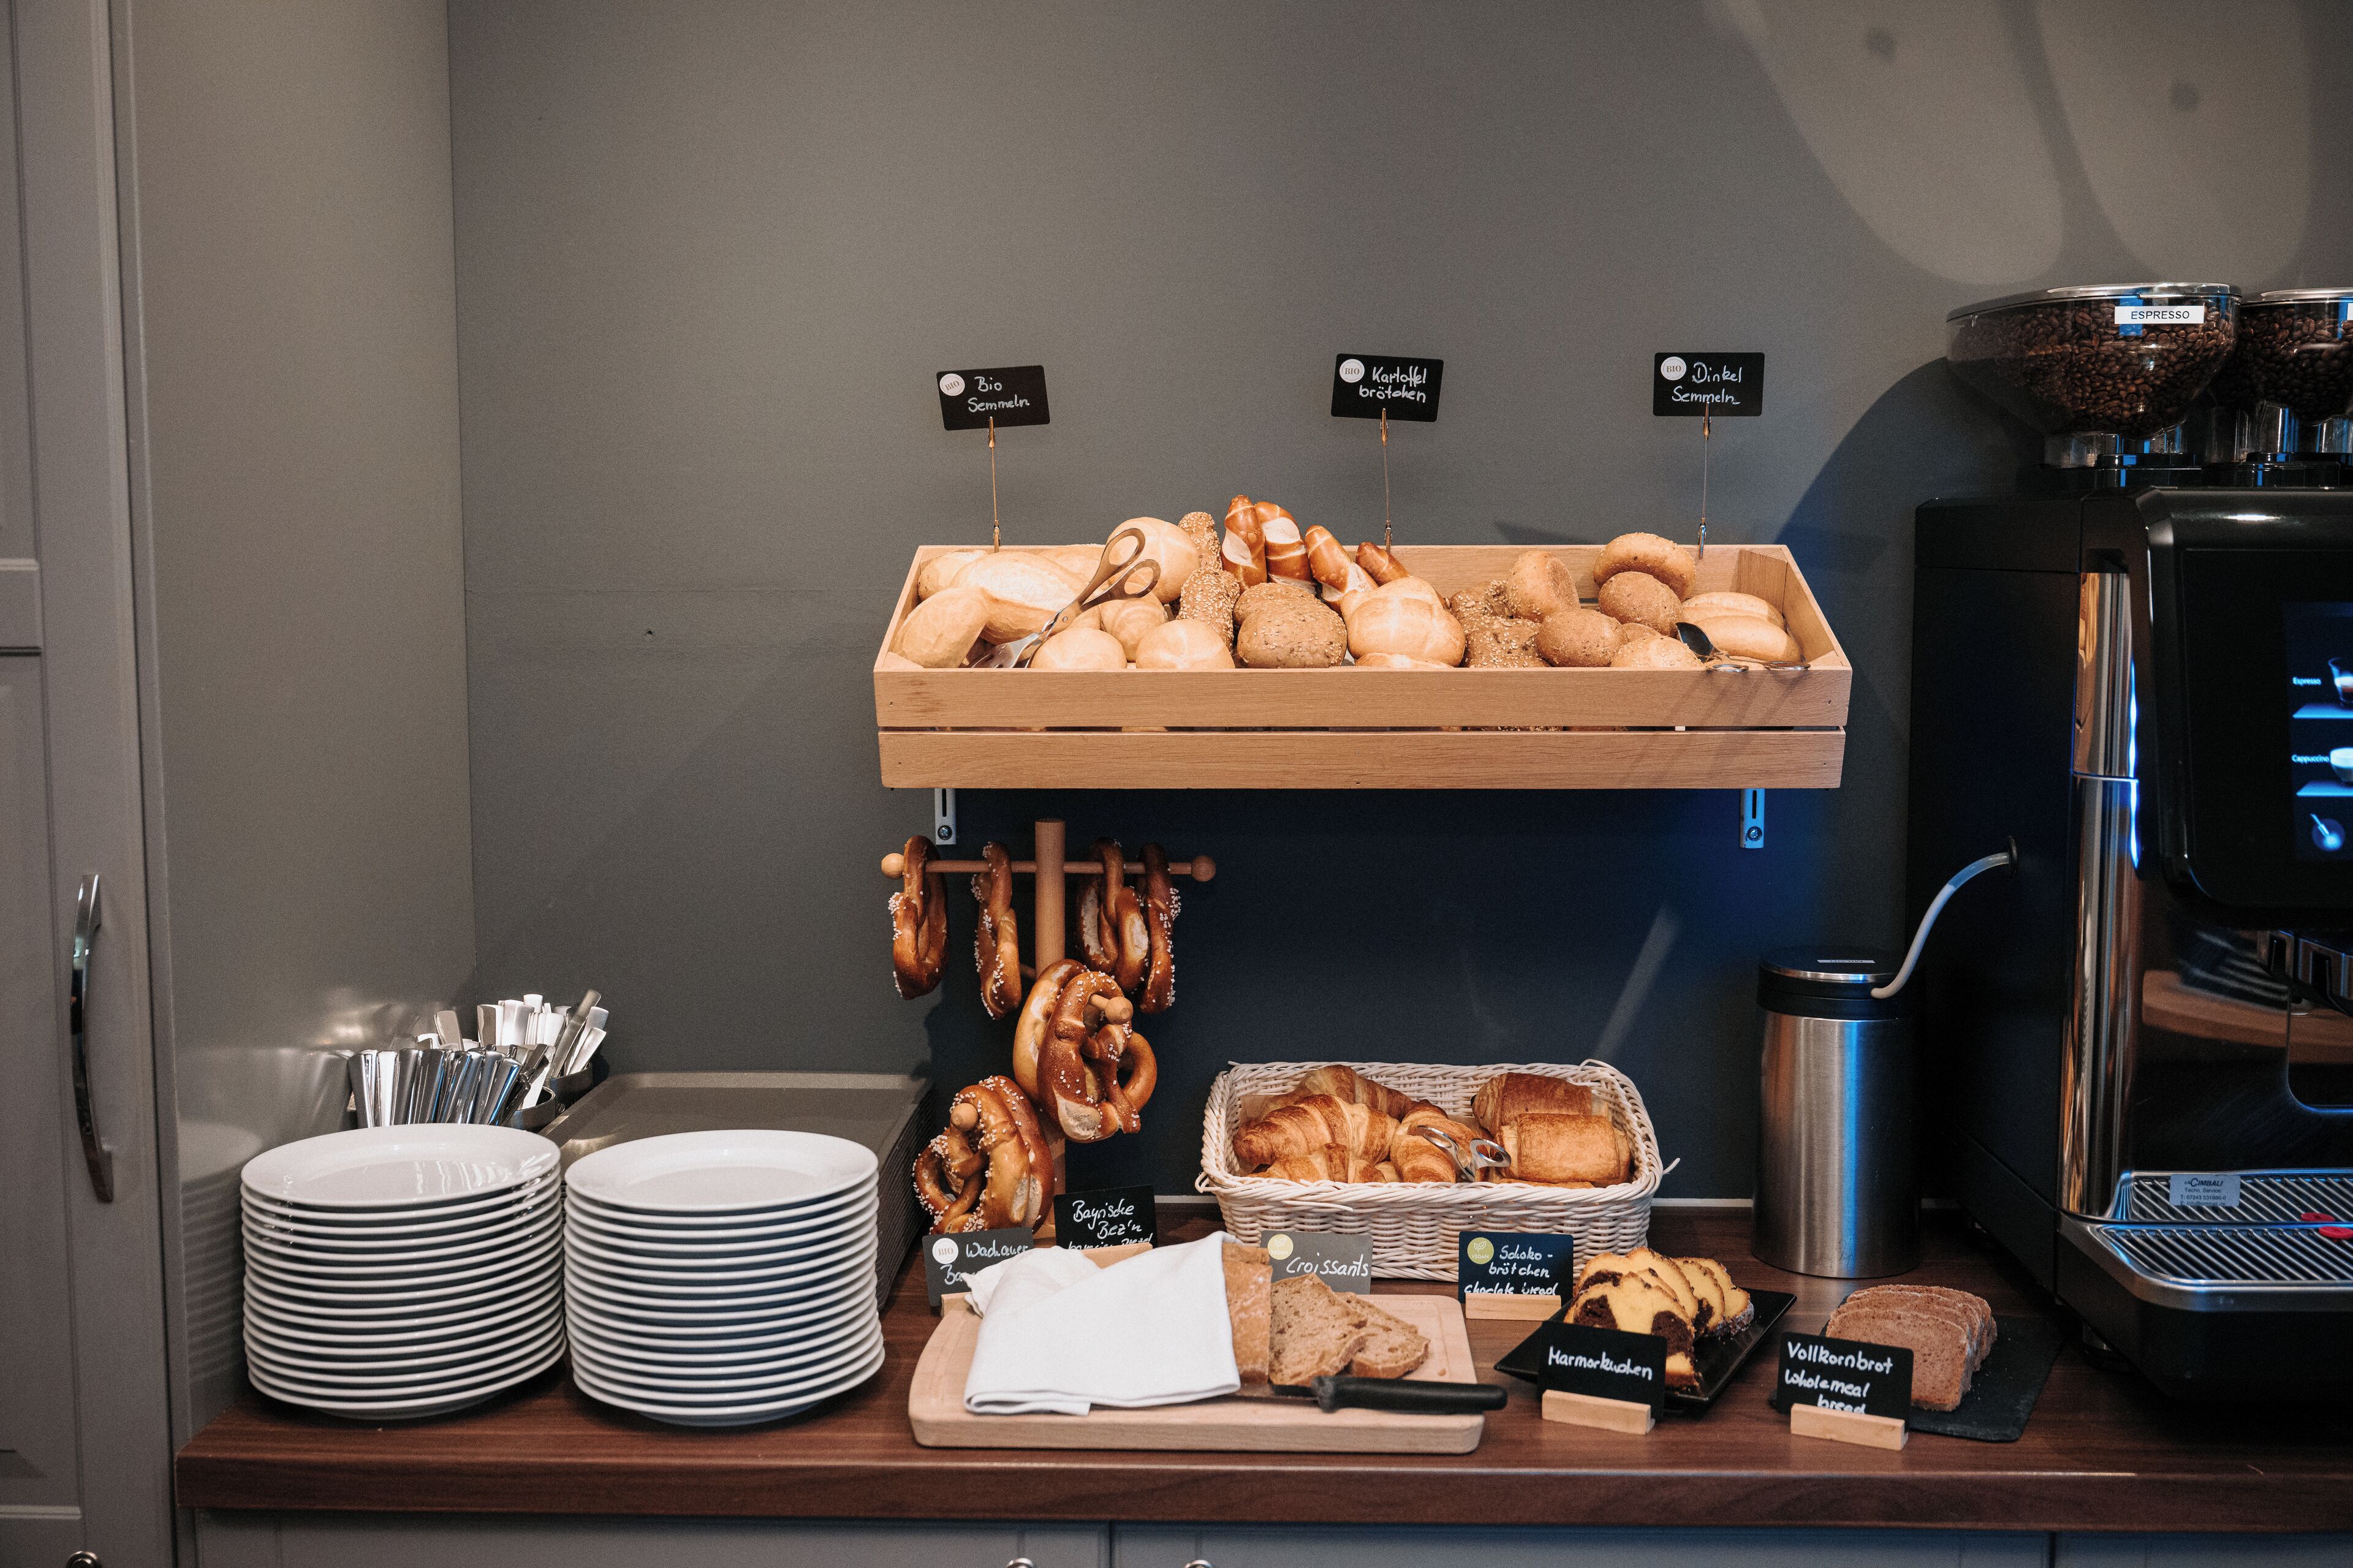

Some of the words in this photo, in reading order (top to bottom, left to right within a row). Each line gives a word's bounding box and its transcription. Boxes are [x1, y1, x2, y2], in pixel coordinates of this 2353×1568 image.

[2131, 311, 2190, 320] ESPRESSO
[1372, 365, 1427, 387] Kartoffel
[1691, 362, 1742, 384] Dinkel
[944, 380, 960, 392] BIO
[974, 376, 1002, 392] Bio
[1358, 384, 1427, 403] brötchen
[1672, 385, 1741, 405] Semmeln
[967, 394, 1030, 413] Semmeln
[2292, 676, 2321, 686] Espresso
[2291, 754, 2330, 764] Cappuccino
[938, 1246, 953, 1256] BIO
[1286, 1252, 1369, 1277] Croissants
[1488, 1262, 1550, 1278] brötchen
[1787, 1341, 1893, 1374] Vollkornbrot
